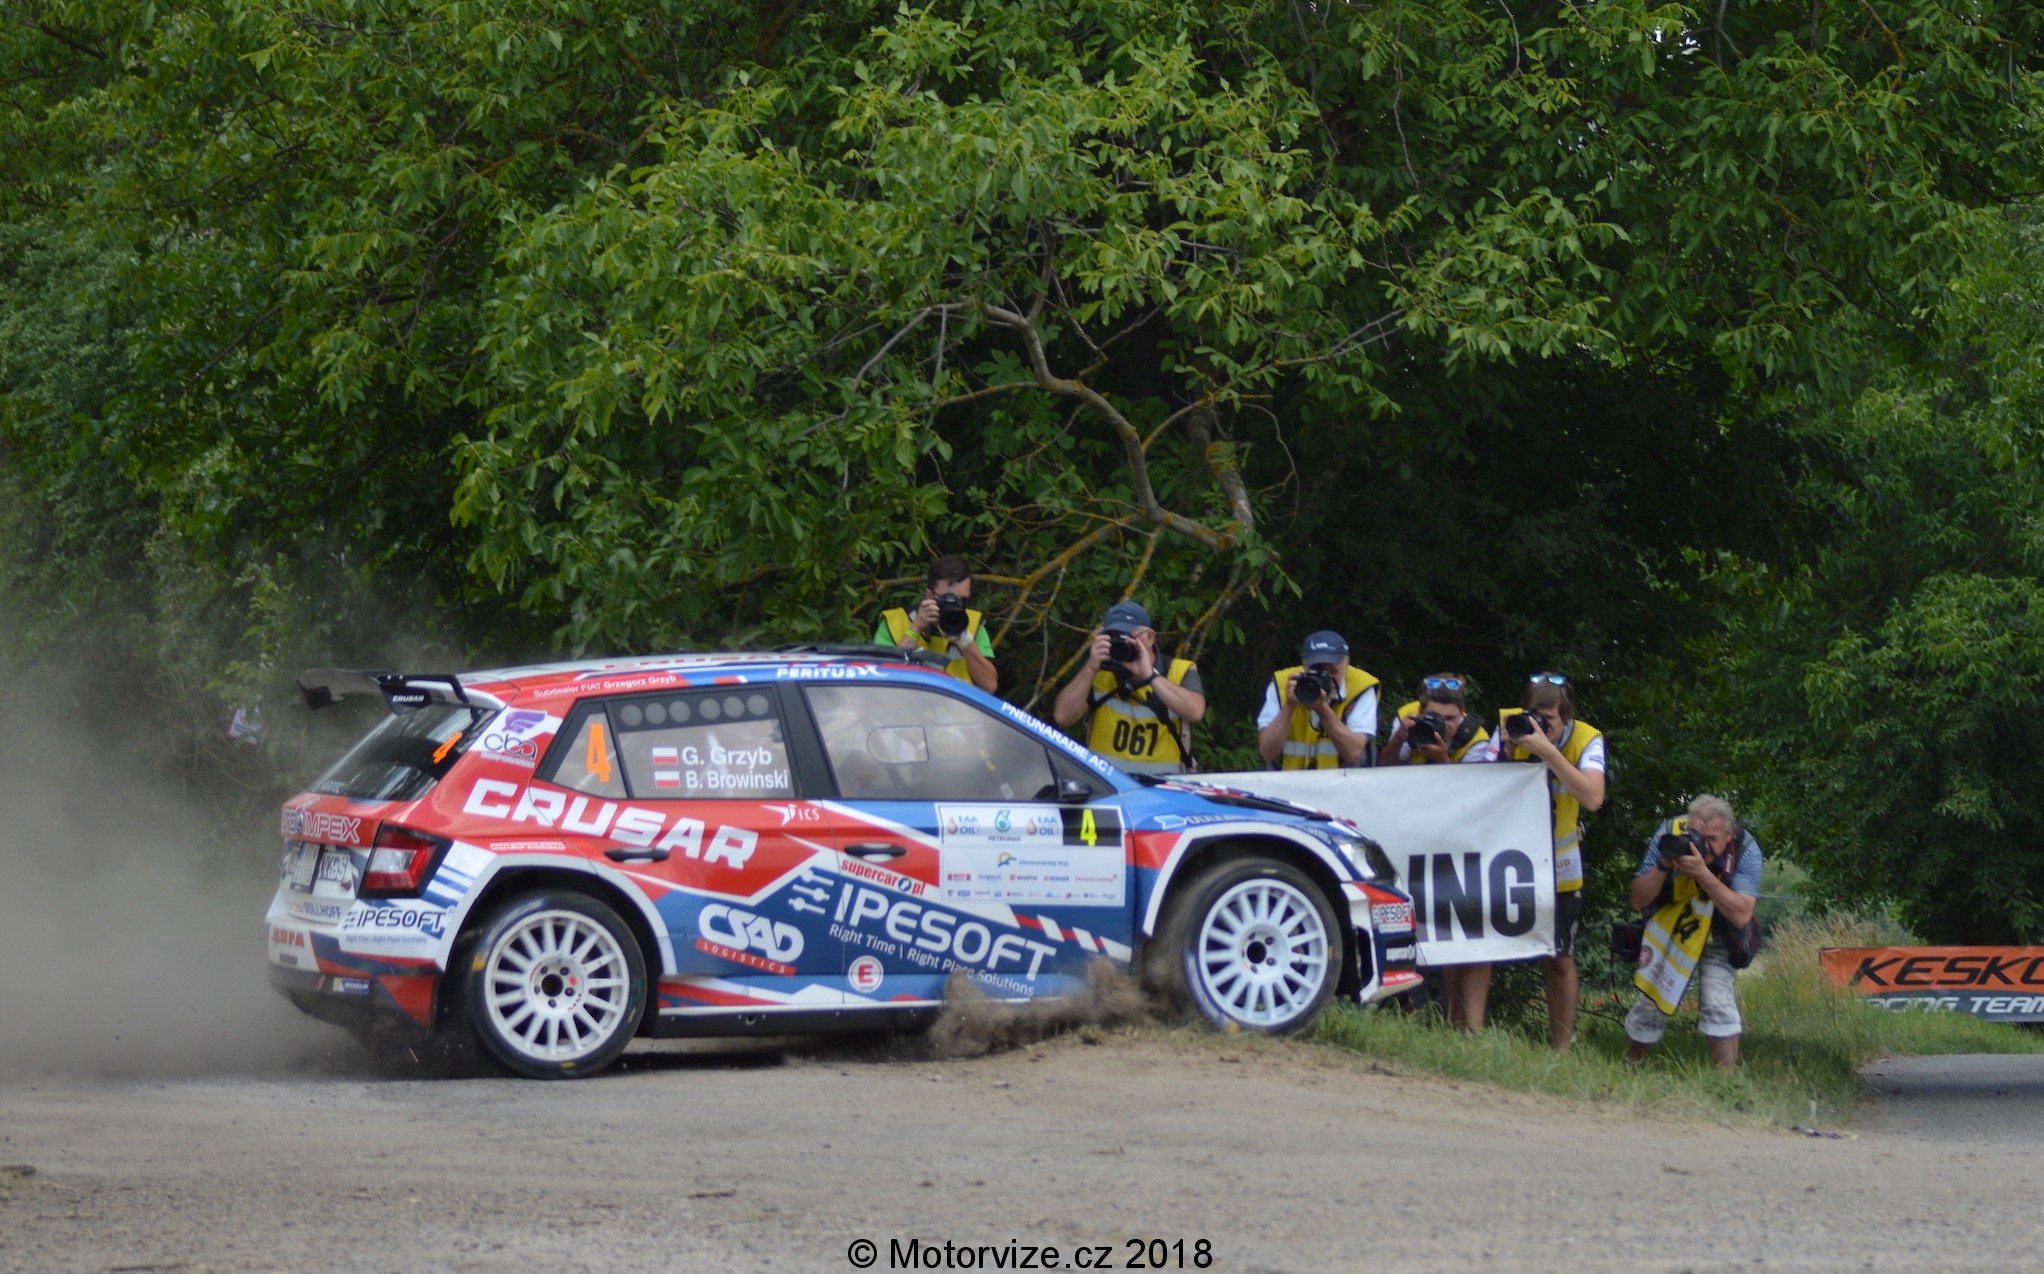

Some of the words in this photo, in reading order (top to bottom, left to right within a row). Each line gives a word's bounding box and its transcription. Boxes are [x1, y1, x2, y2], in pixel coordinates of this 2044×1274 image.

[533, 684, 579, 698] Subdealer
[581, 682, 601, 692] FIAT
[603, 677, 647, 690] Grzegorz
[648, 674, 677, 685] Grzyb
[776, 665, 857, 679] PERITUS
[392, 695, 424, 703] CRUSAR
[1001, 701, 1090, 759] PNEUNARADIE
[1113, 719, 1159, 756] 067
[432, 731, 463, 764] 4
[586, 723, 612, 783] 4
[682, 746, 705, 766] G.
[710, 746, 773, 770] Grzyb
[685, 772, 703, 789] B.
[707, 770, 788, 789] Browinski
[463, 778, 759, 870] CRUSAR
[960, 826, 977, 835] OIL
[1039, 827, 1056, 836] OIL
[1080, 809, 1098, 847] 4
[356, 909, 446, 933] IPESOFT
[698, 902, 805, 964] CSAD
[834, 882, 1057, 982] IPESOFT
[702, 940, 786, 974] LOGISTICS
[829, 922, 861, 945] Right
[866, 933, 895, 956] Time
[907, 947, 941, 971] Right
[942, 958, 975, 980] Place
[976, 966, 1035, 998] Solutions
[858, 964, 873, 984] E
